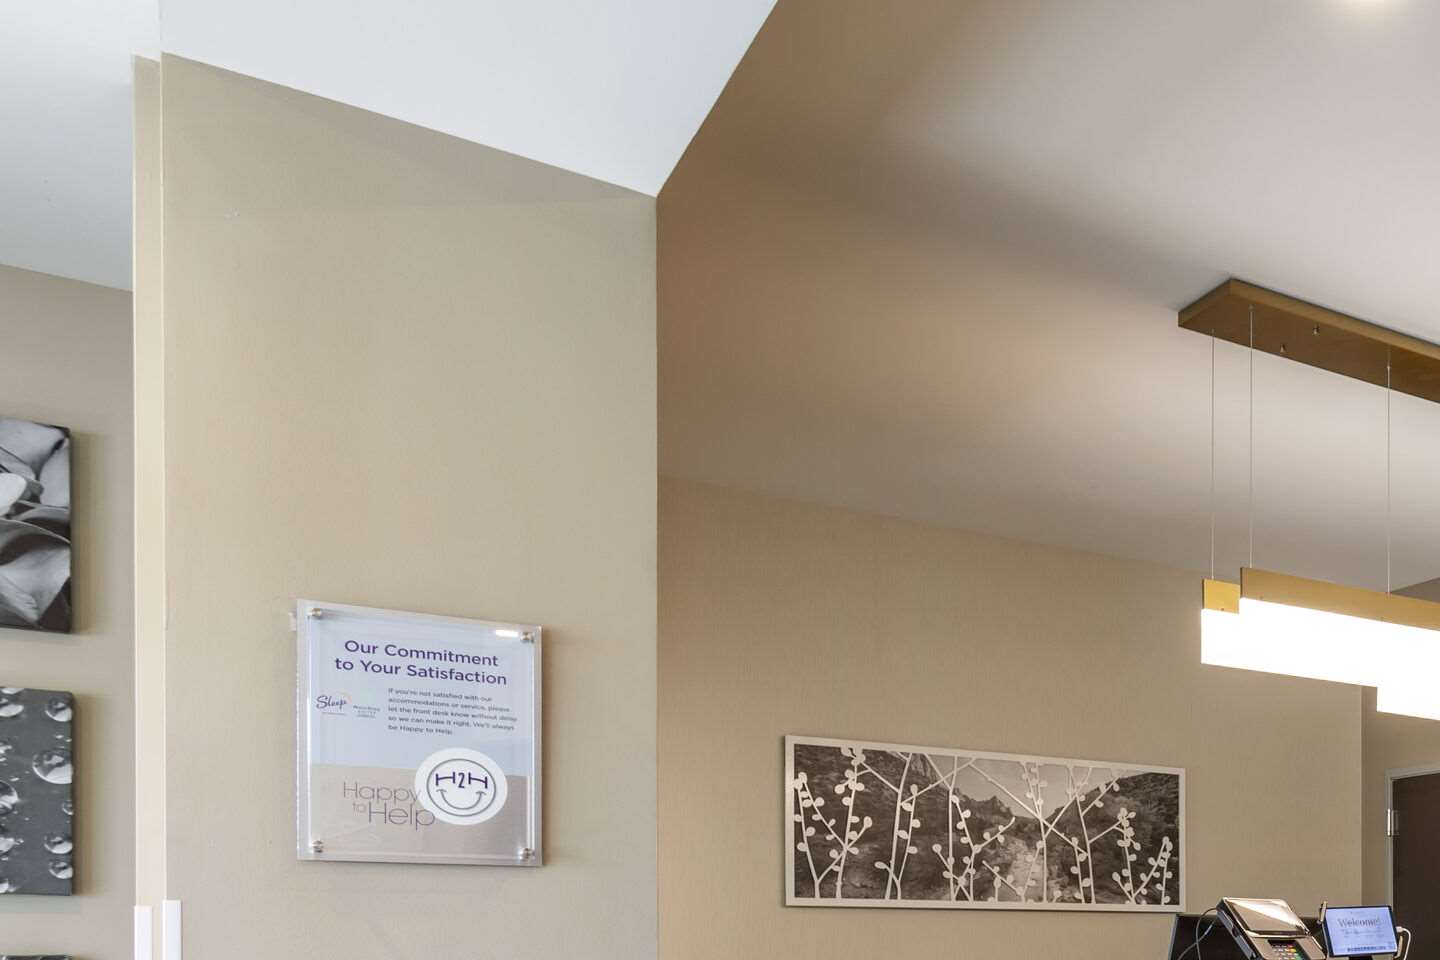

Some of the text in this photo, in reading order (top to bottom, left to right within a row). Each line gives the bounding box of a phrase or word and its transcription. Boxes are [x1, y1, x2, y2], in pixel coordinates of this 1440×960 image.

[344, 640, 499, 667] Our Commitment
[335, 658, 507, 685] to Your Satisfaction
[435, 771, 488, 789] H2H
[343, 781, 421, 805] Happy
[352, 802, 367, 813] to
[368, 801, 436, 831] Help
